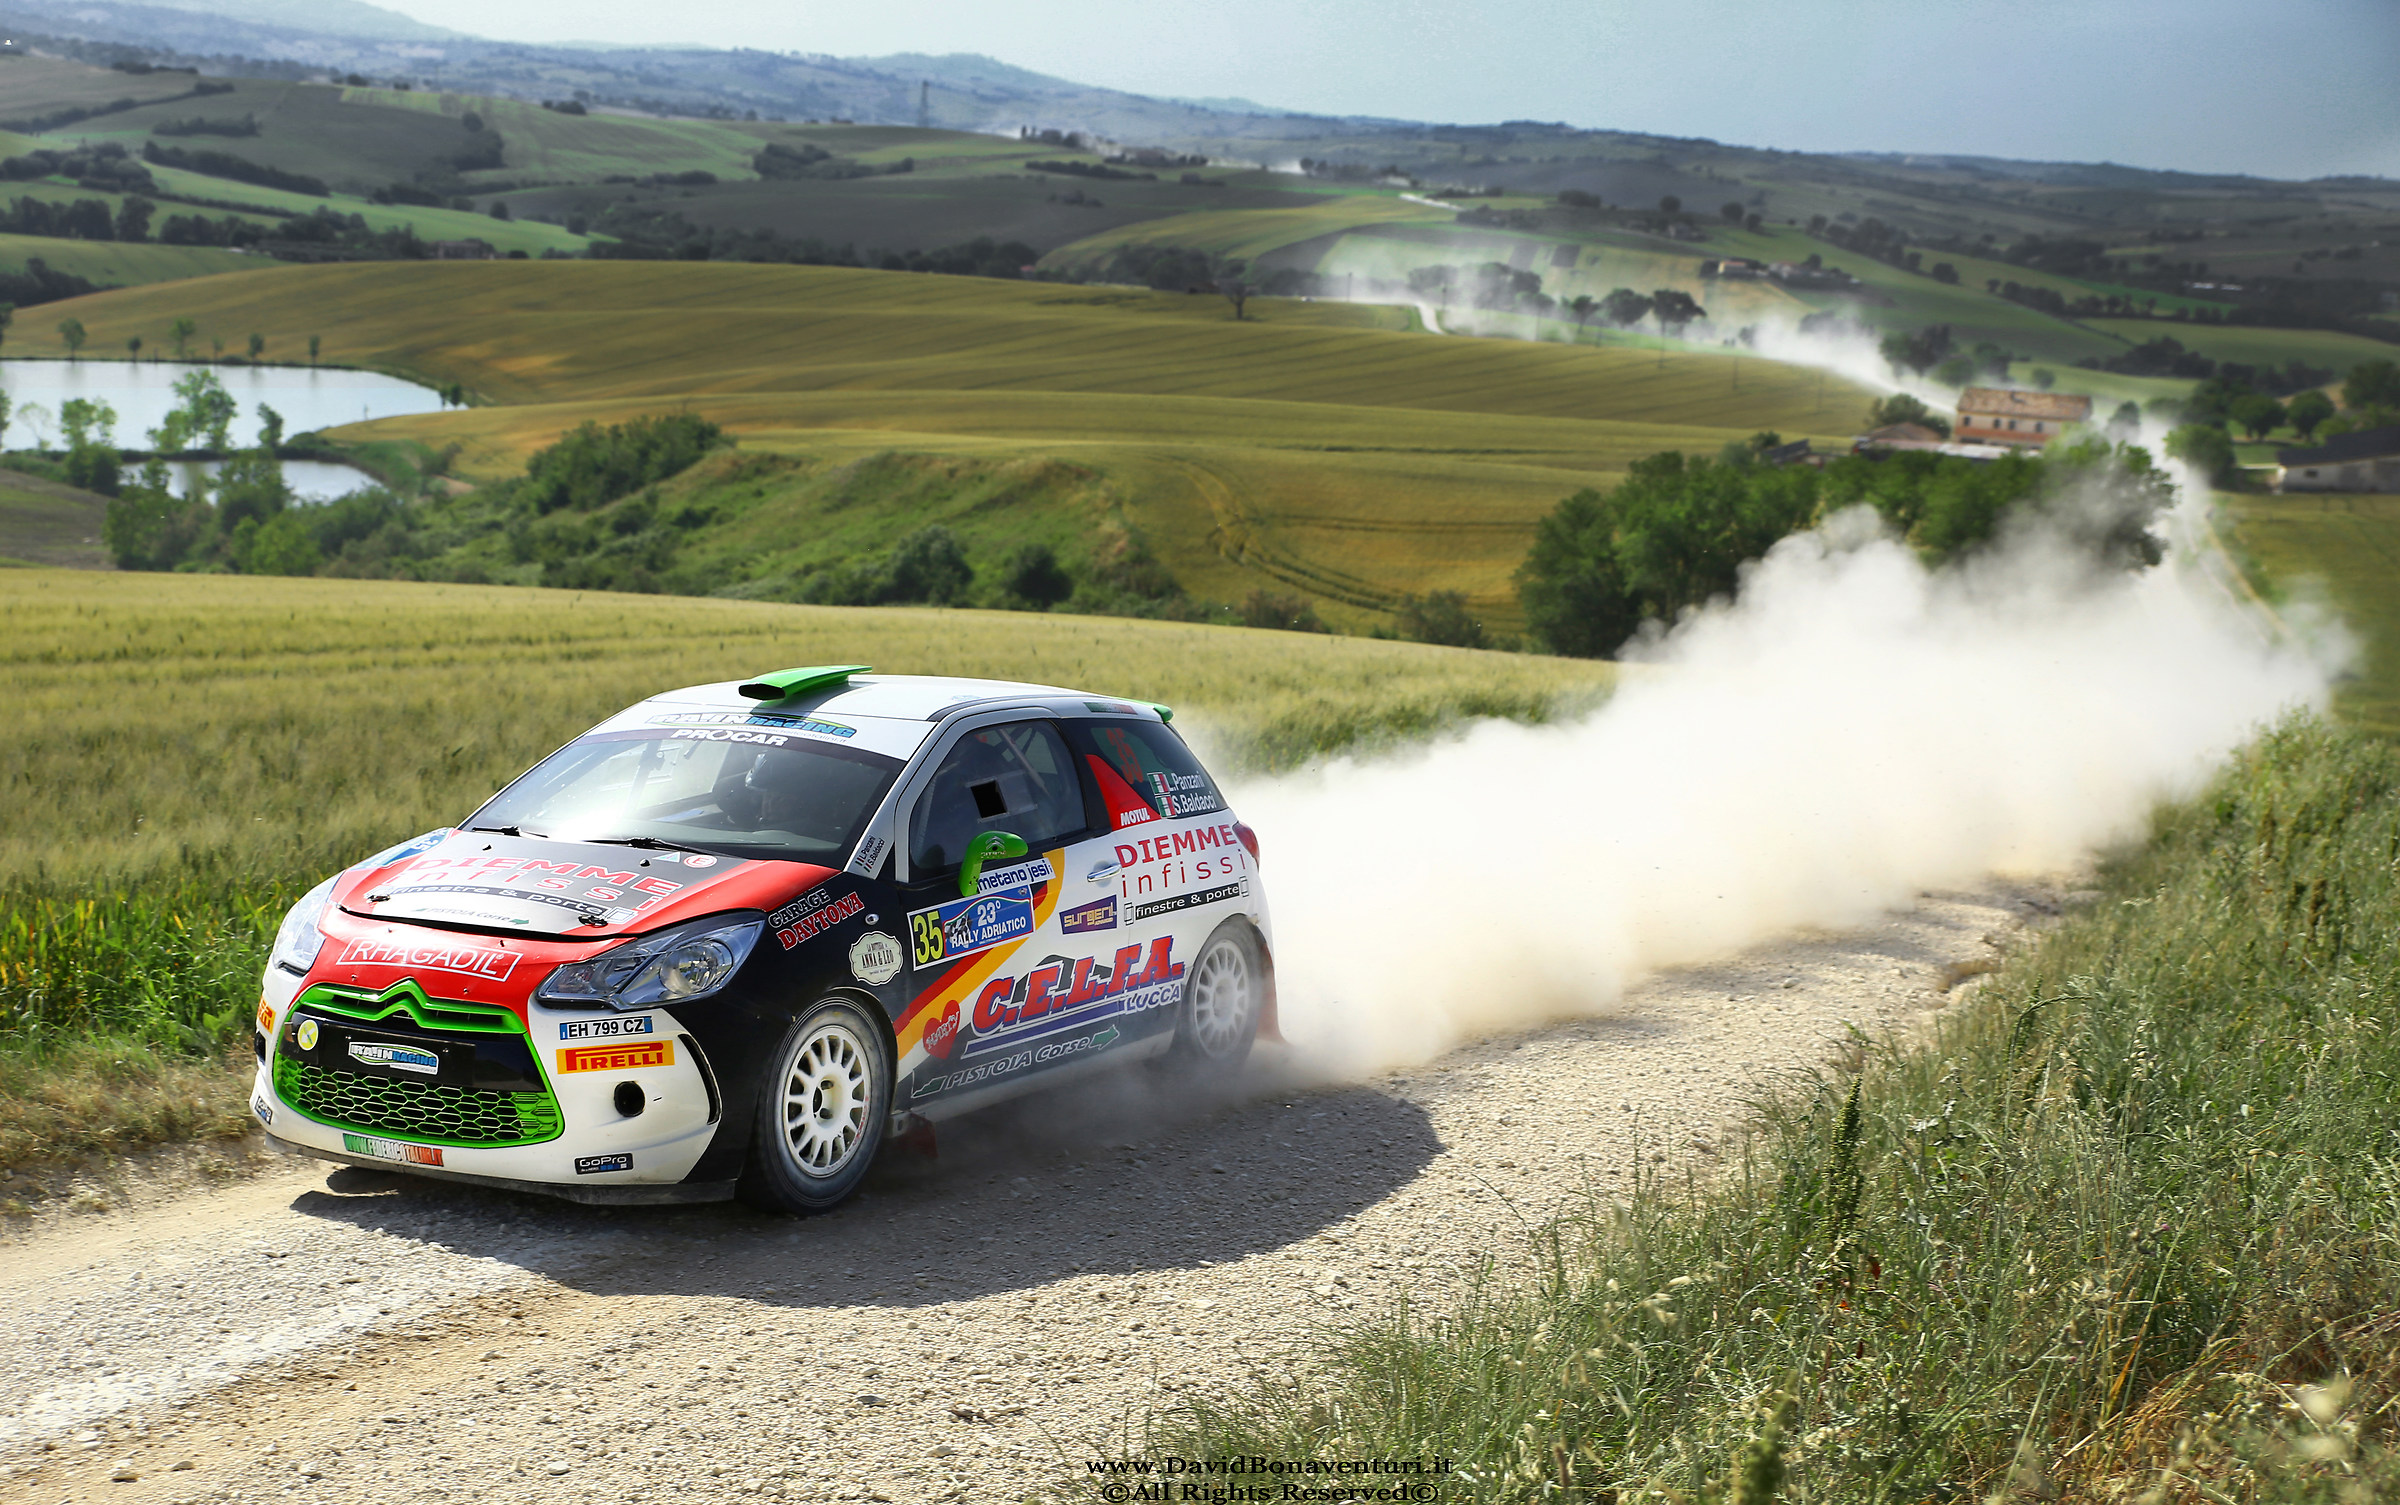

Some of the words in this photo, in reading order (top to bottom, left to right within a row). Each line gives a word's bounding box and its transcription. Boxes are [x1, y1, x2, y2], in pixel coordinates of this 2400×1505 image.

[671, 729, 788, 747] PROCAR
[1120, 807, 1150, 826] MOTUL
[1114, 824, 1237, 868] DIEMME
[406, 855, 684, 897] DIEMME
[978, 868, 1028, 891] metano
[1026, 860, 1051, 882] jesi
[1121, 848, 1247, 898] infissi
[498, 888, 519, 897] &
[527, 892, 604, 916] porte
[768, 888, 831, 928] GARAGE
[1136, 898, 1185, 918] finestre
[1191, 894, 1201, 903] &
[1206, 886, 1239, 902] porte
[776, 891, 865, 951] DAYTONA
[913, 910, 944, 964] 35
[951, 928, 980, 948] RALLY
[981, 916, 1027, 940] ADRIATICO
[1126, 985, 1181, 1012] LUCCA
[568, 1023, 588, 1037] EH
[593, 1022, 618, 1036] 799
[623, 1018, 644, 1032] CZ
[565, 1042, 664, 1071] PIRELLI
[946, 1050, 1031, 1090] PISTOIA
[1036, 1037, 1090, 1062] Corse
[580, 1156, 627, 1167] GoPro
